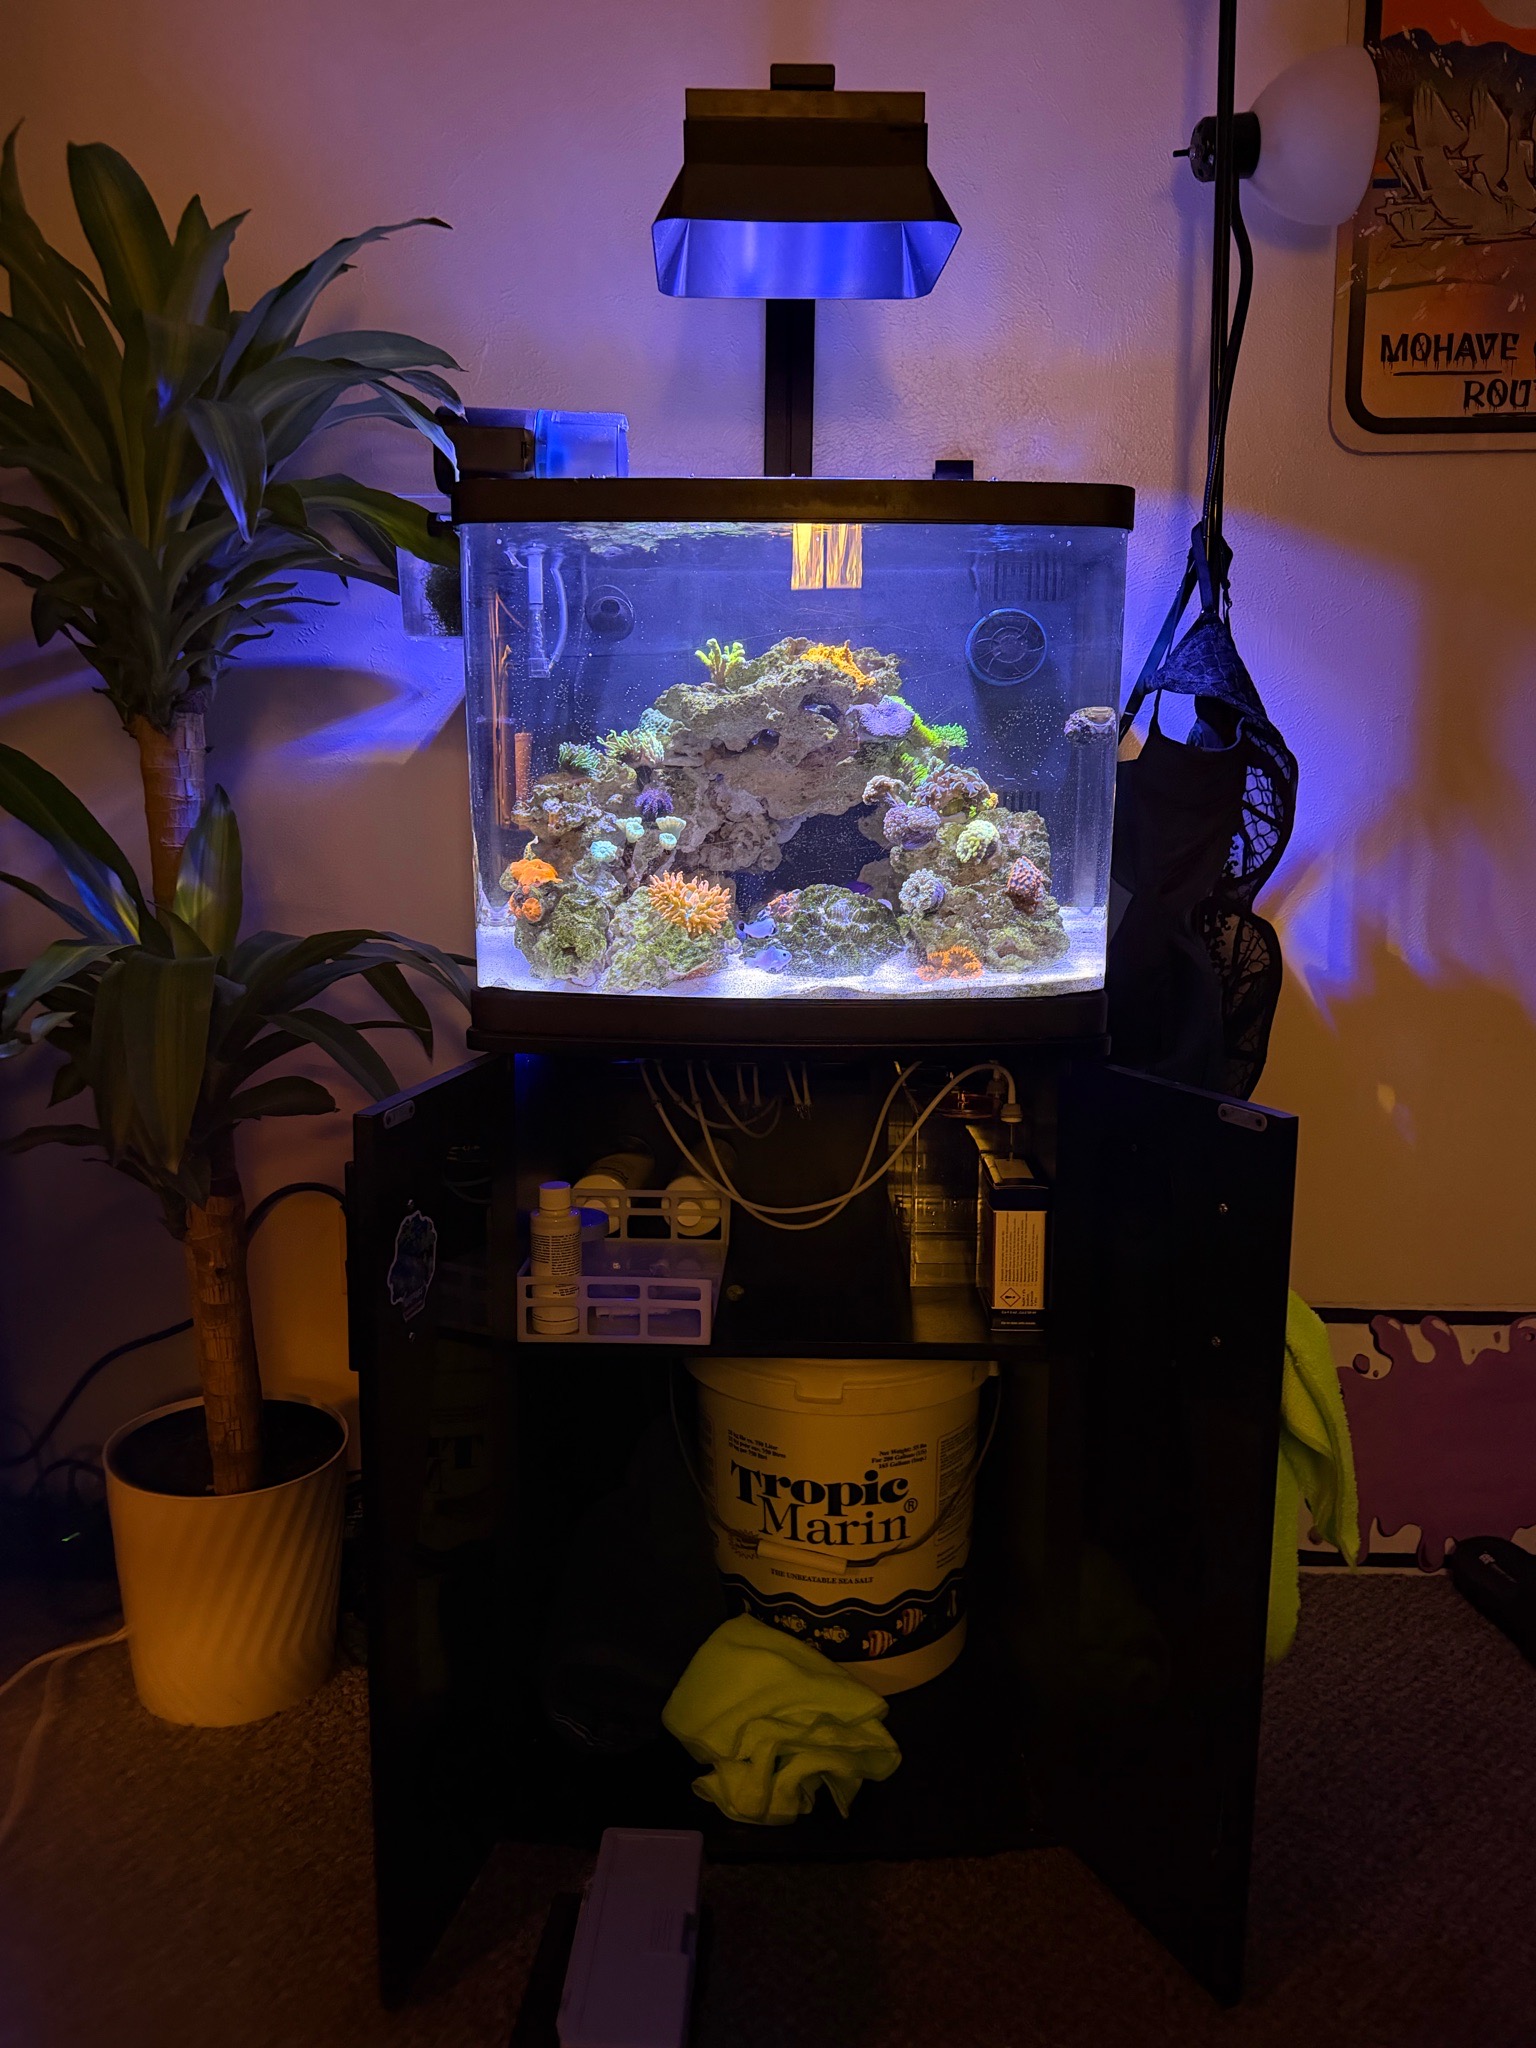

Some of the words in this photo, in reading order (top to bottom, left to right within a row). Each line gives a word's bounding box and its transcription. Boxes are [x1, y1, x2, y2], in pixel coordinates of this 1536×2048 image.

[1380, 332, 1520, 365] MOHAVE
[1462, 379, 1536, 411] ROU
[731, 1459, 909, 1516] Tropic
[770, 1568, 786, 1577] THE
[786, 1571, 837, 1584] UNBEATABLE
[854, 1576, 875, 1584] SALT
